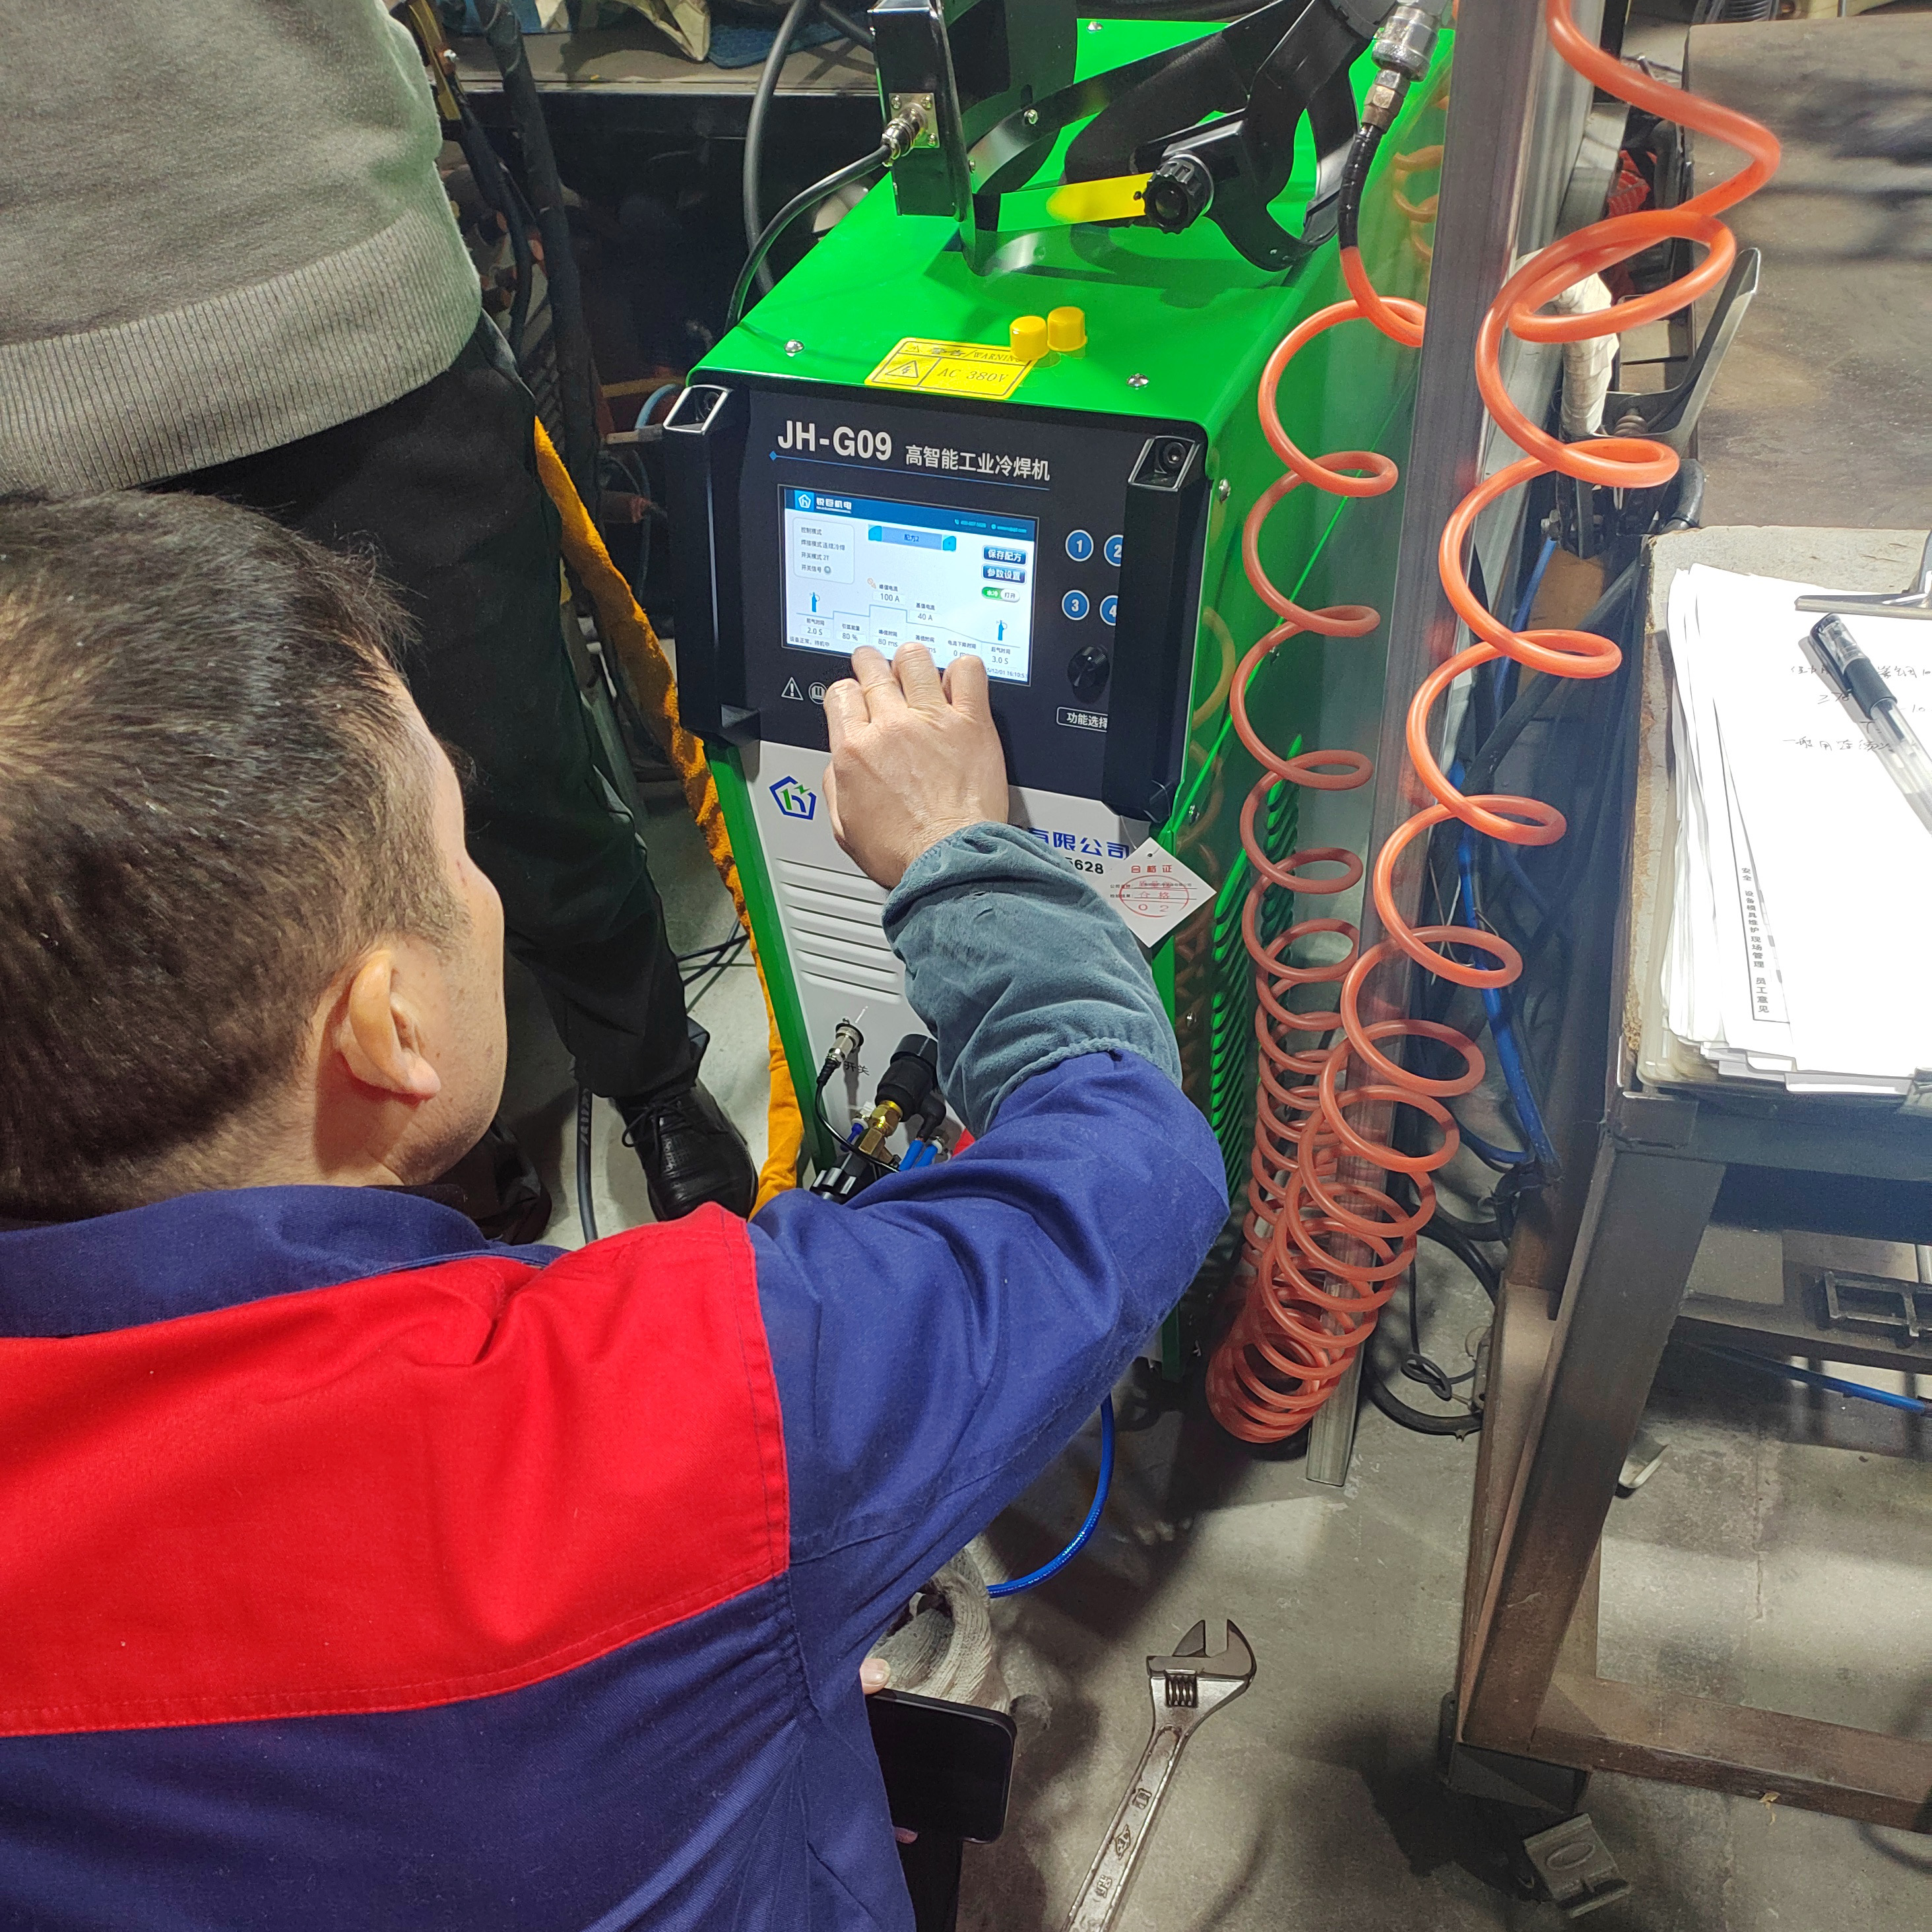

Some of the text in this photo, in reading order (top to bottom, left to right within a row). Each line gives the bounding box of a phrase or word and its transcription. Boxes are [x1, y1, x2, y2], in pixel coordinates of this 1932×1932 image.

[937, 368, 1009, 382] AC 380V
[777, 420, 1050, 482] JH-G09 高智能工业冷焊机
[1076, 539, 1083, 552] 1
[1114, 544, 1122, 558] 2
[988, 549, 1022, 562] 保存配方
[987, 567, 1021, 581] 参数设置
[880, 593, 893, 601] 100
[1072, 598, 1079, 612] 3
[1109, 604, 1117, 618] 4
[1066, 712, 1108, 730] 功能选择
[1065, 856, 1104, 874] 628
[844, 1060, 870, 1076] 开关
